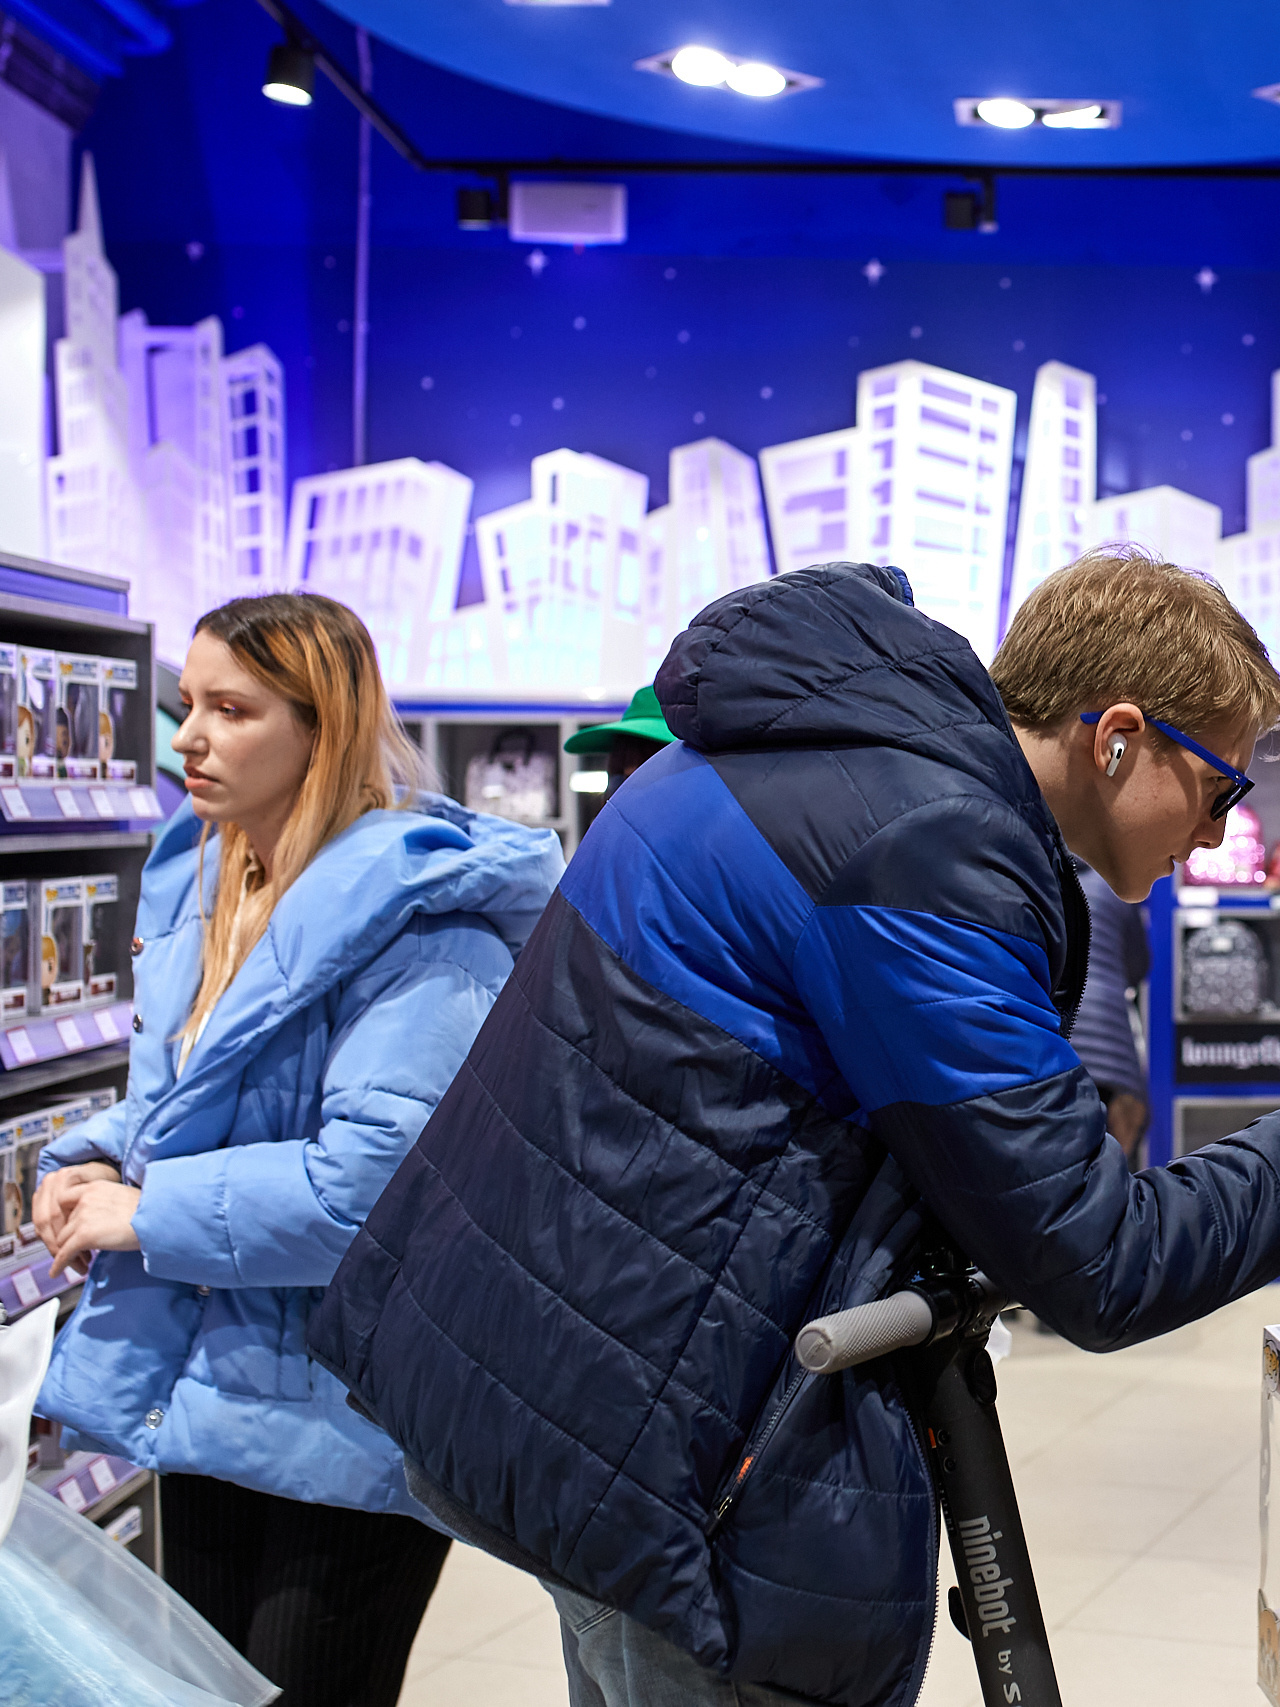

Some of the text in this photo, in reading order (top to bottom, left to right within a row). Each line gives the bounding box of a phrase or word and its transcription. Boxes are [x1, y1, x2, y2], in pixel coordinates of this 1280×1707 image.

[958, 1514, 1023, 1707] ninebot by S
